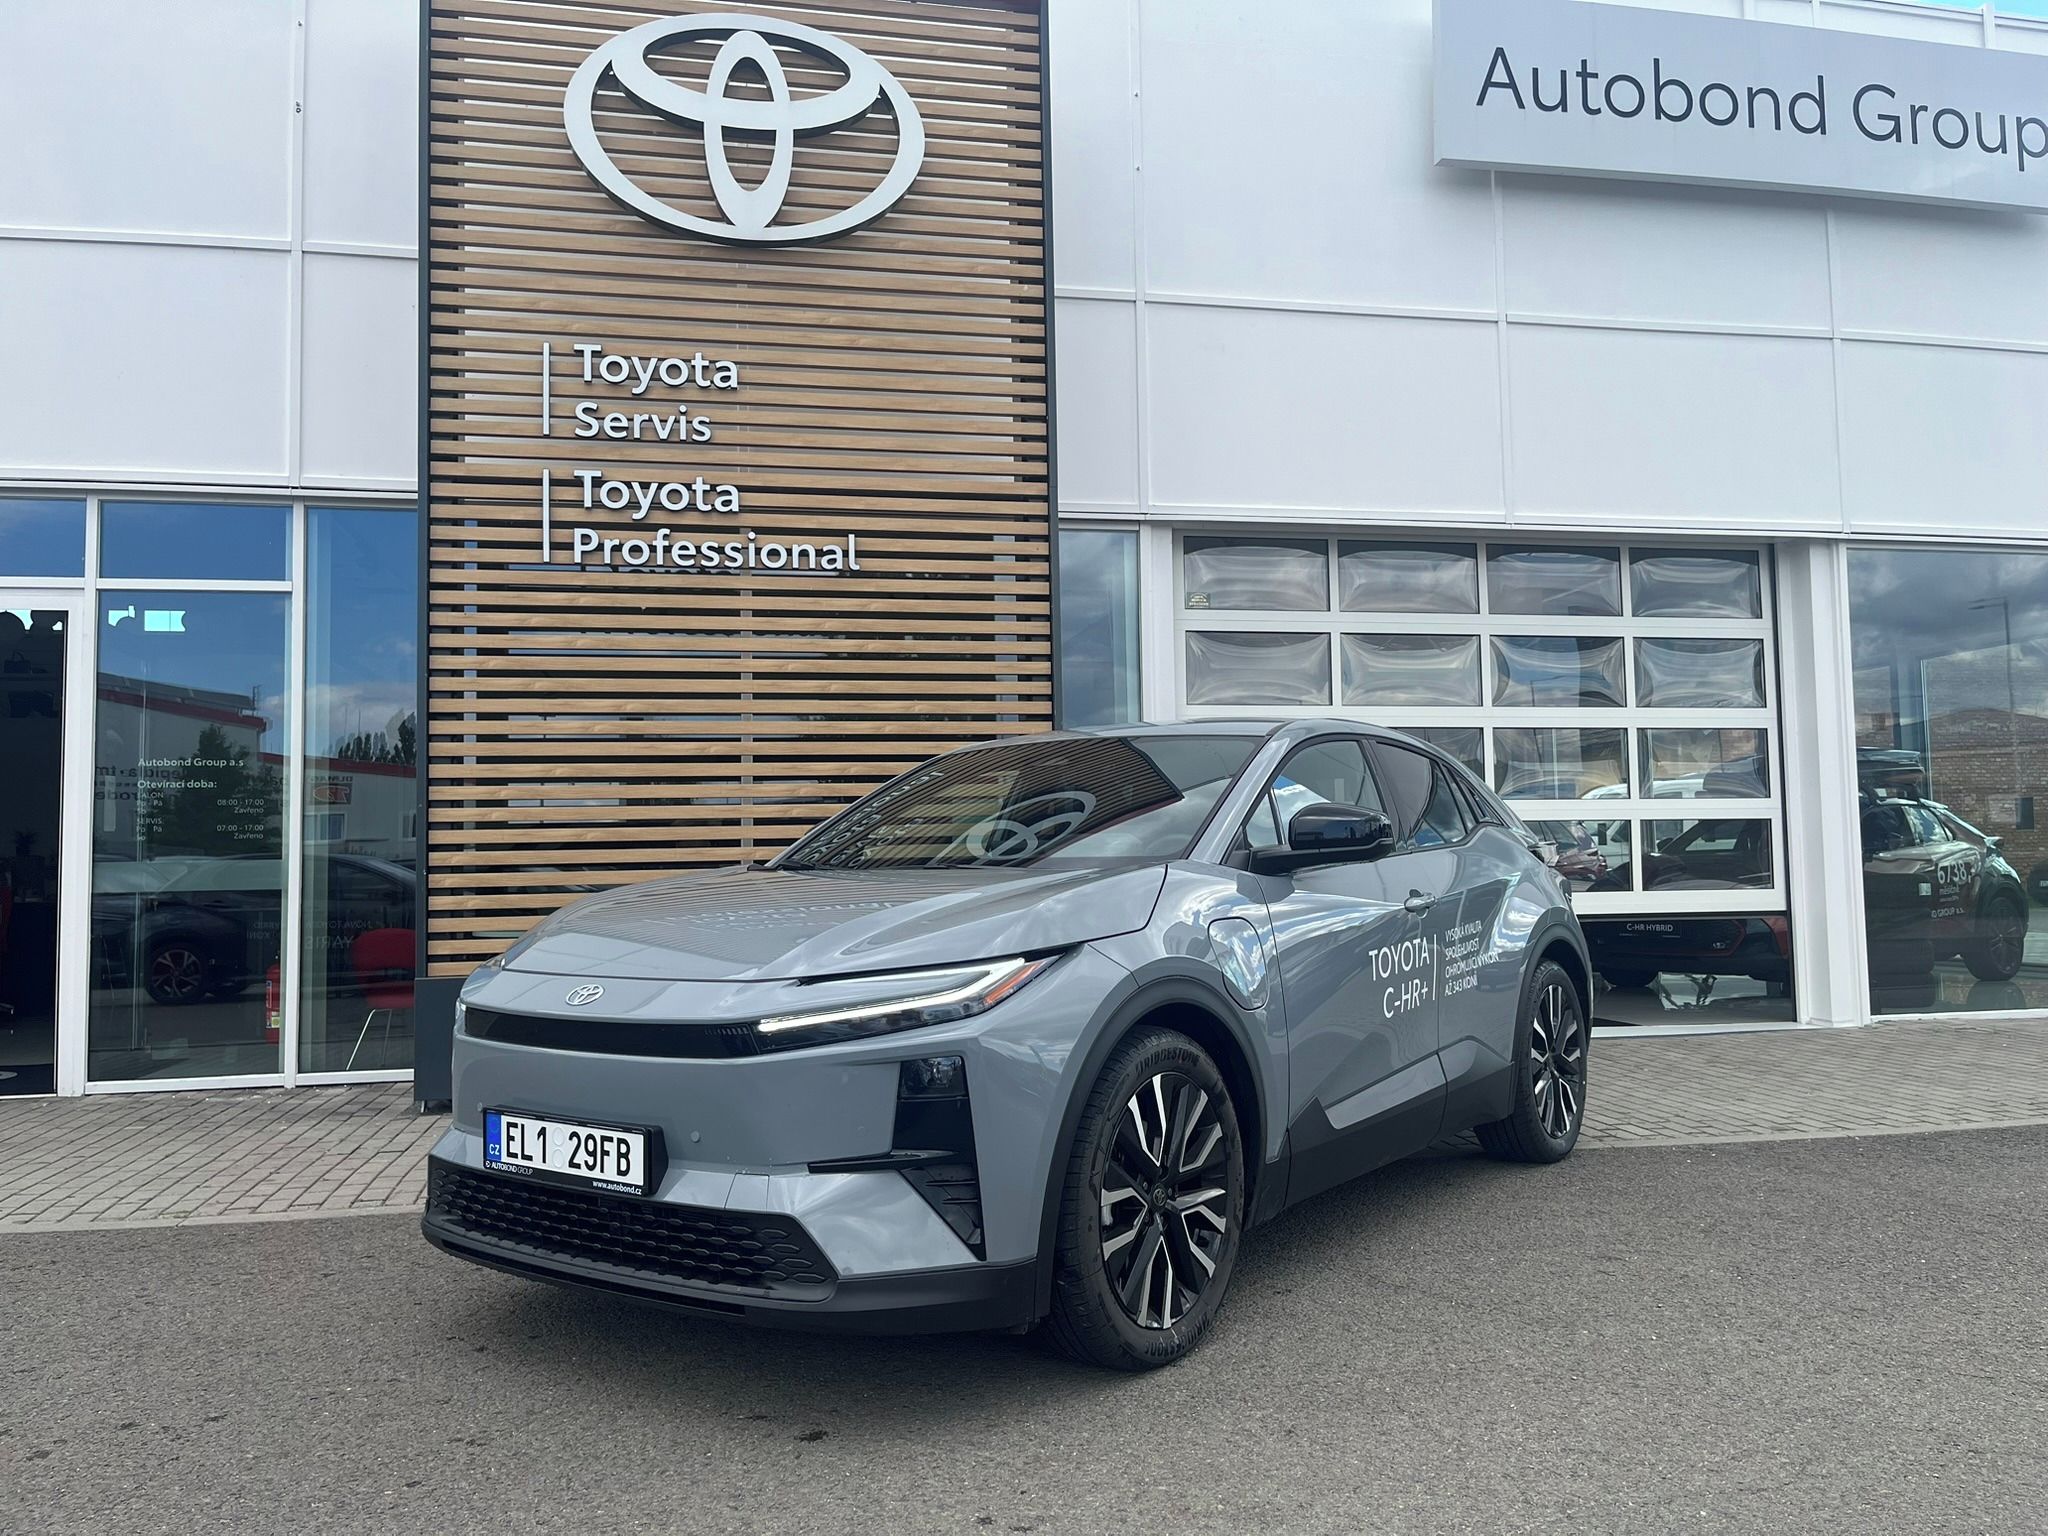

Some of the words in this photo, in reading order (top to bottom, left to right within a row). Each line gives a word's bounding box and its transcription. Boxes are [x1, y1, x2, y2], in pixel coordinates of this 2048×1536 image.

[1476, 46, 1827, 136] Autobond
[1852, 83, 2048, 172] Group
[573, 344, 739, 395] Toyota
[574, 401, 712, 442] Servis
[573, 470, 740, 520] Toyota
[573, 528, 860, 571] Professional
[138, 757, 191, 767] Autobond
[193, 758, 227, 768] Group
[137, 780, 185, 789] Otevírací
[187, 780, 217, 789] doba:
[1646, 924, 1674, 932] HYBRID
[1369, 937, 1430, 981] TOYOTA
[1383, 978, 1428, 1018] C-HR+
[489, 1143, 500, 1156] CZ
[491, 1161, 517, 1174] AUTOBOND
[517, 1167, 534, 1176] GROUP
[506, 1121, 547, 1164] EL1
[568, 1131, 631, 1177] 29FB
[592, 1180, 642, 1196] www.autobond.cz
